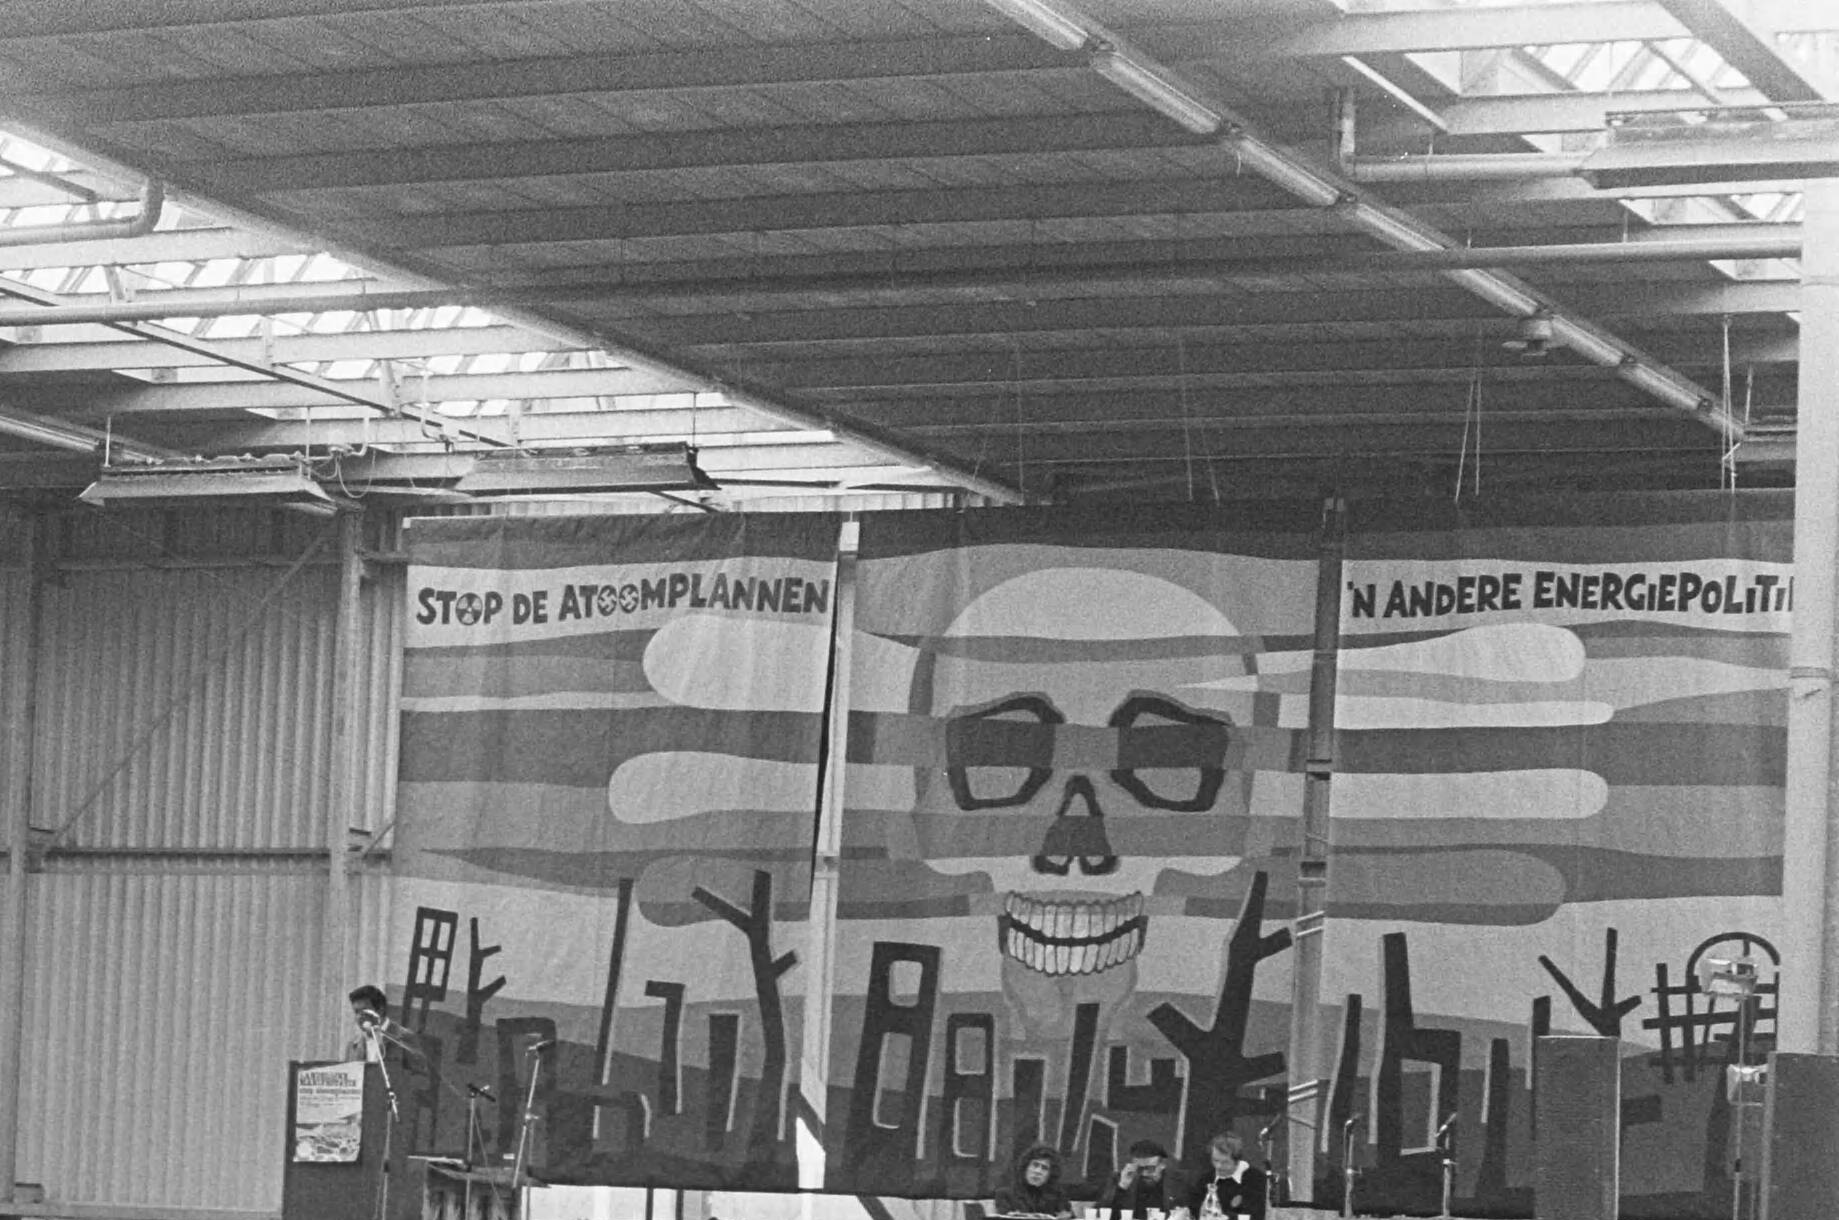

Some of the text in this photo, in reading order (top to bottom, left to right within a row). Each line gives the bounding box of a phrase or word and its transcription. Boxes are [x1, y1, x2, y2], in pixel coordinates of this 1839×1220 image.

[416, 572, 829, 626] STOP DE ATOOMPLANNEN
[1347, 571, 1794, 618] 'N ANDERE ENERGIEPOLITI
